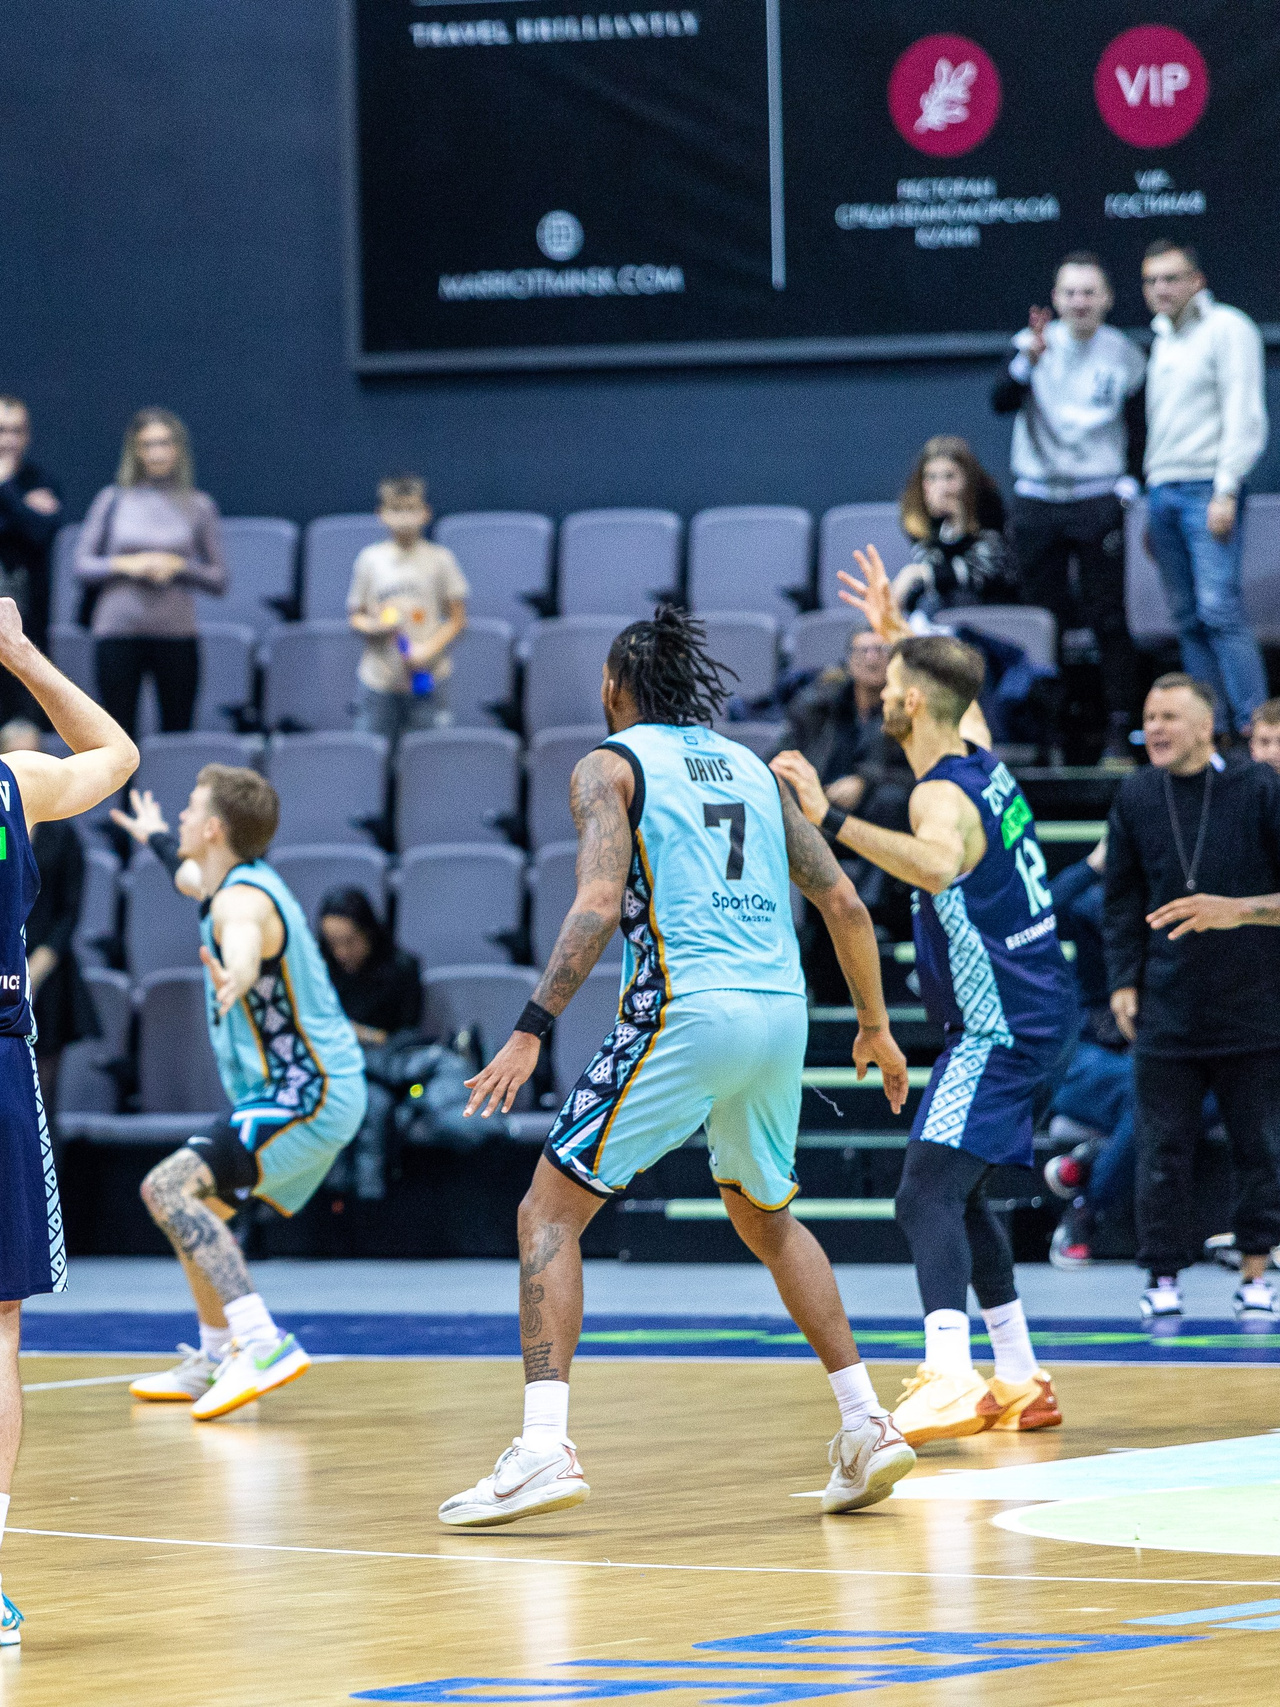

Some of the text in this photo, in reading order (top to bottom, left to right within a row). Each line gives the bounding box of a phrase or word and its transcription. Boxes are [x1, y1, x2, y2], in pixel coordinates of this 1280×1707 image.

[410, 20, 512, 47] TRAVEL
[1115, 62, 1190, 107] VIP
[685, 757, 733, 782] DAVIS
[703, 802, 746, 880] 7
[1015, 837, 1053, 917] 12
